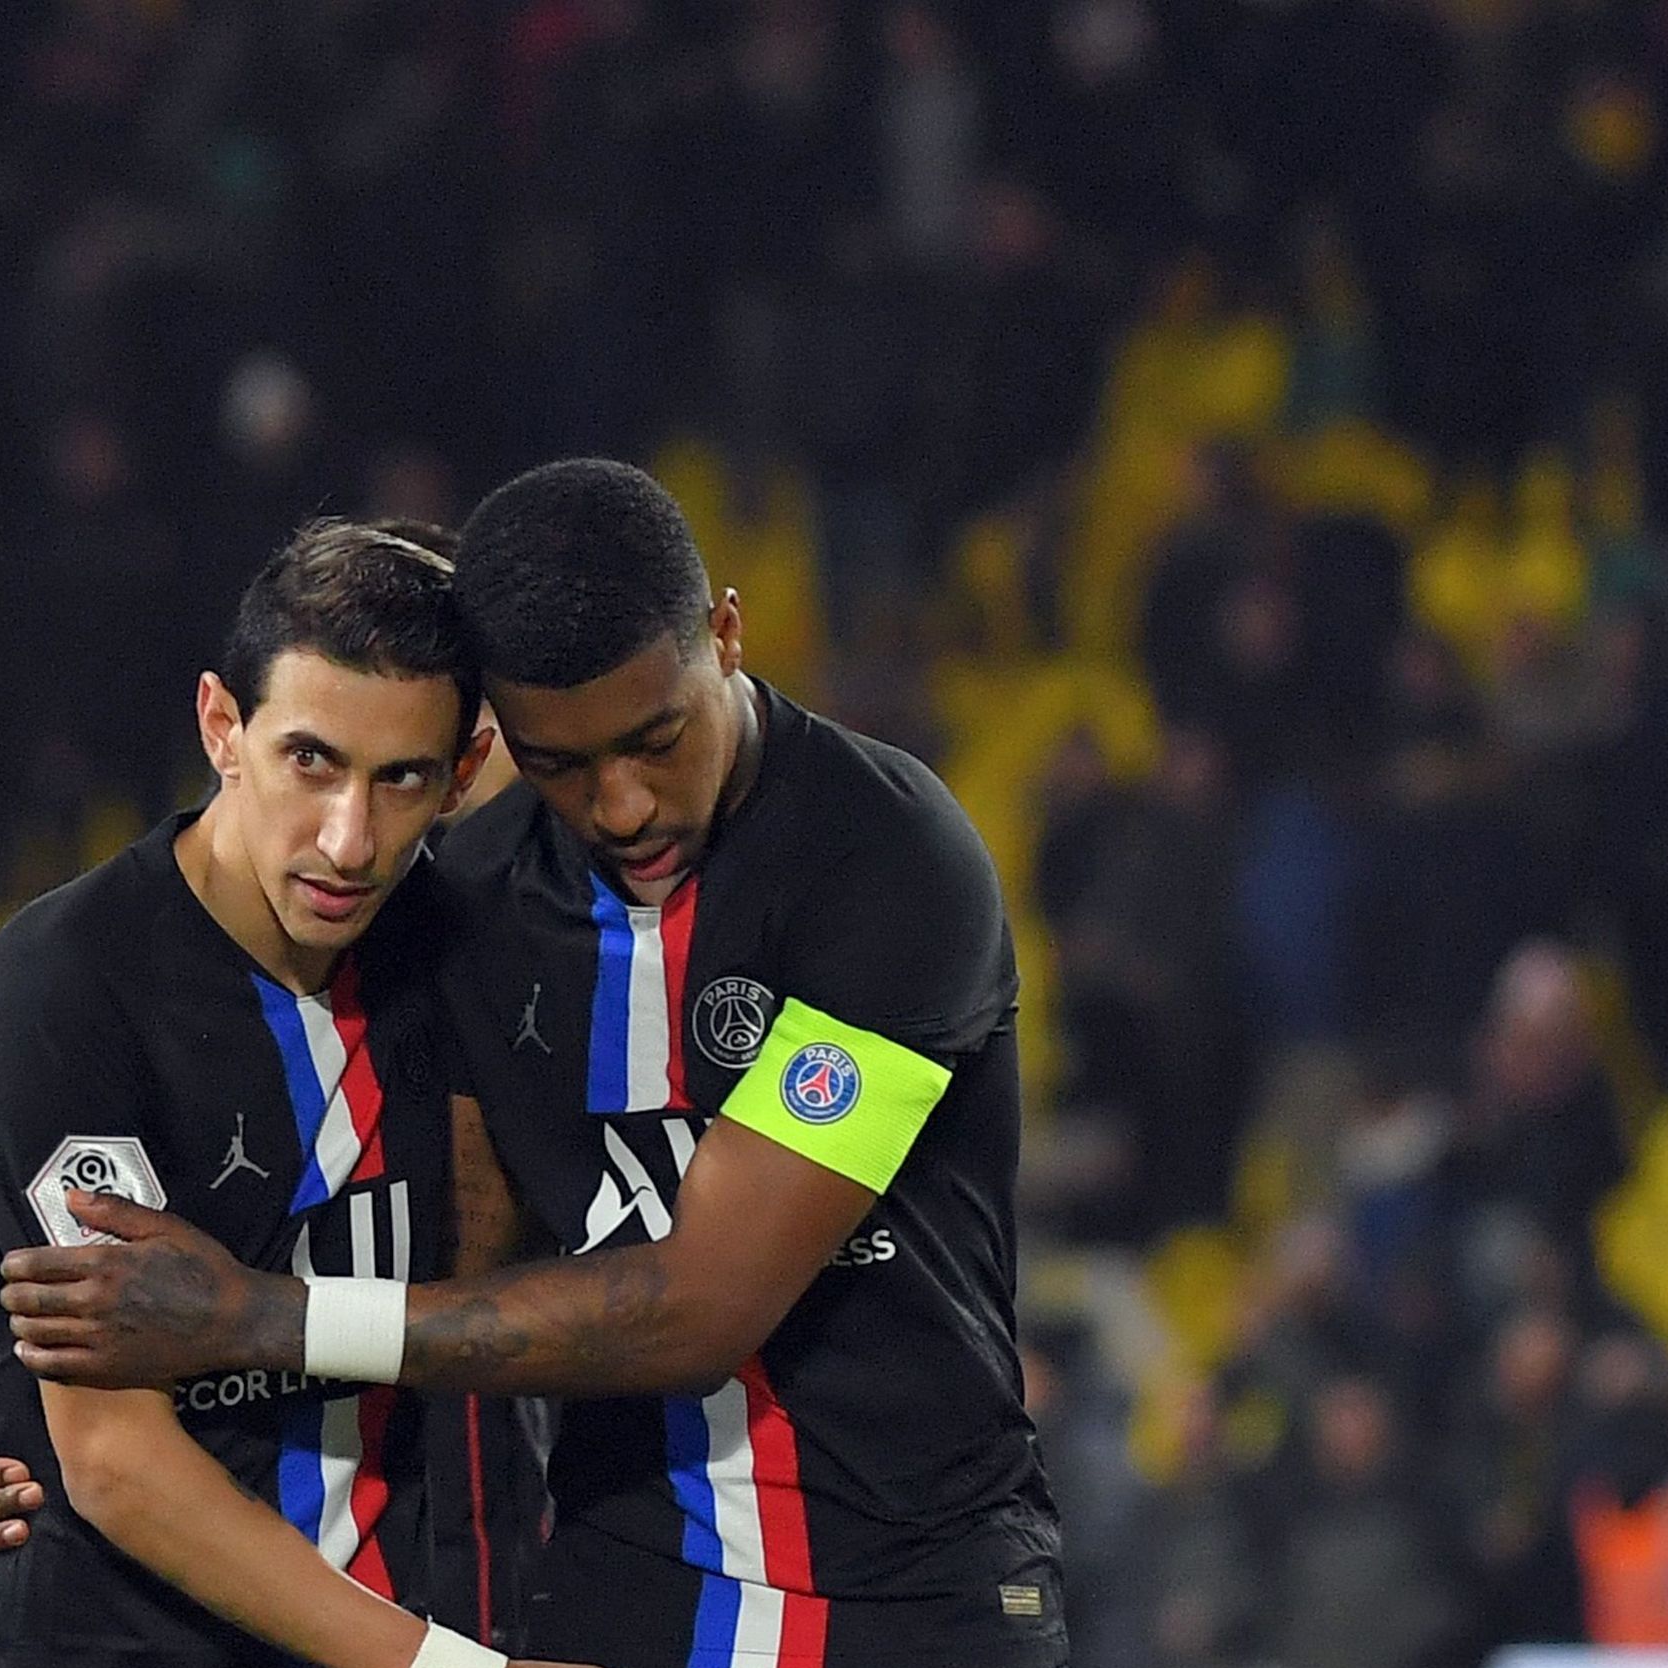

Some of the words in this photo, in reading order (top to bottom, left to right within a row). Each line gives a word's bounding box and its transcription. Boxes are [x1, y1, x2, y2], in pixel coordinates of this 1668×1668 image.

[704, 981, 762, 1006] PARIS
[805, 1048, 856, 1078] PARIS
[174, 1369, 272, 1411] COR
